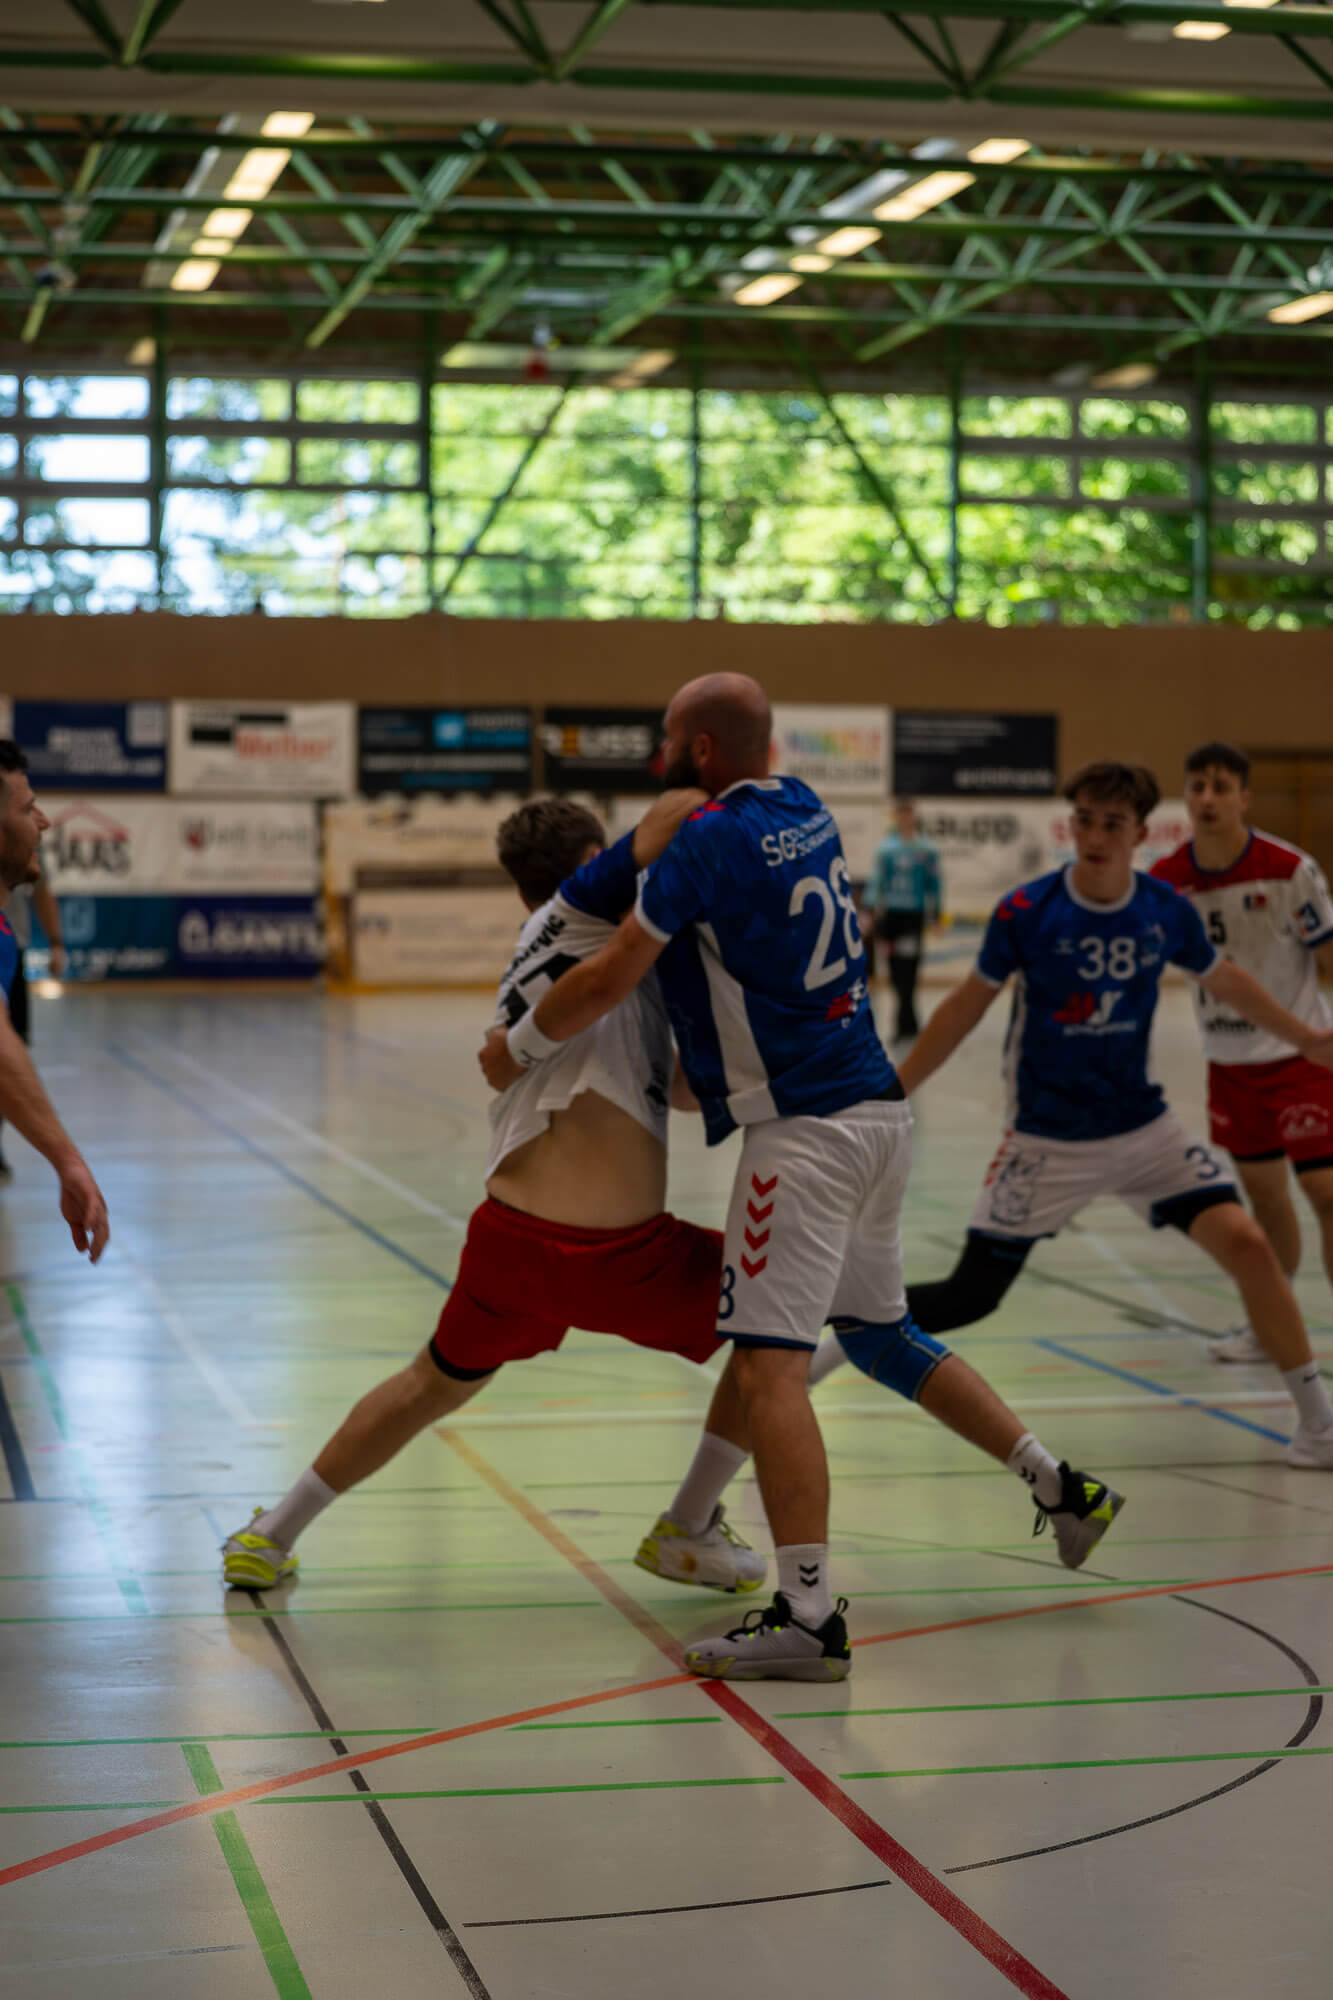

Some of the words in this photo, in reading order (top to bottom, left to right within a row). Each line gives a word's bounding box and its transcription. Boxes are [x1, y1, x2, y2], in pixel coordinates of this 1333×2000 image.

[761, 830, 797, 867] SG
[788, 856, 864, 992] 28
[1077, 936, 1138, 982] 38
[1184, 1146, 1221, 1180] 3
